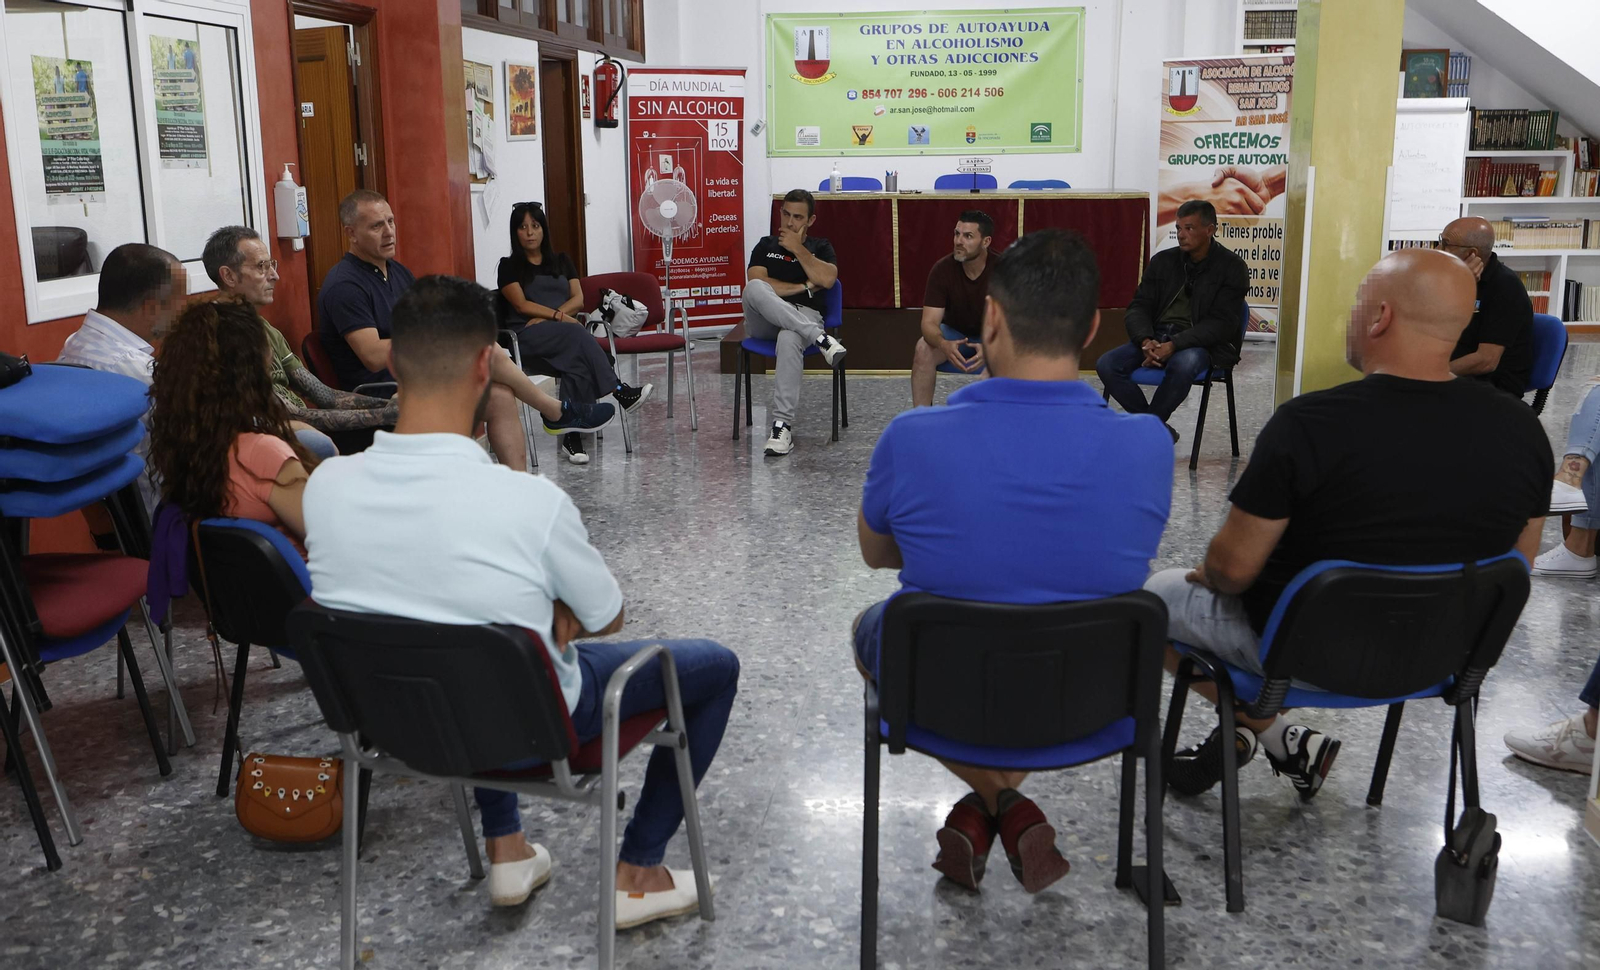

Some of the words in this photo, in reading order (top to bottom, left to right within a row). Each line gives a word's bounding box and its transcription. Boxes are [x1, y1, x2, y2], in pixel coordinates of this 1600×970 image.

[860, 24, 926, 36] GRUPOS
[928, 23, 949, 34] DE
[954, 21, 1050, 34] AUTOAYUDA
[886, 39, 907, 50] EN
[911, 37, 1024, 50] ALCOHOLISMO
[871, 54, 880, 65] Y
[886, 53, 939, 65] OTRAS
[944, 52, 1039, 64] ADICCIONES
[1202, 66, 1250, 80] ASOCIACIÓN
[1251, 67, 1262, 78] DE
[649, 78, 668, 92] DÍA
[672, 78, 725, 92] MUNDIAL
[1227, 80, 1290, 94] REHABILITADOS
[862, 89, 882, 100] 854
[884, 88, 902, 100] 707
[908, 88, 928, 99] 296
[938, 87, 958, 98] 606
[961, 87, 981, 98] 214
[984, 87, 1004, 98] 506
[638, 100, 662, 115] SIN
[667, 100, 737, 116] ALCOHOL
[1238, 98, 1254, 108] SAN
[1256, 96, 1276, 108] JOSÉ
[890, 105, 975, 115] ar.san.jose@hotmail.com
[1235, 116, 1247, 126] AR
[1248, 114, 1265, 125] SAN
[1266, 112, 1288, 124] JOSÉ
[715, 122, 728, 136] 15
[711, 137, 737, 149] nov.
[1194, 132, 1281, 150] OFRECEMOS
[1168, 154, 1216, 165] GRUPOS
[1218, 154, 1234, 164] DE
[705, 178, 714, 186] La
[715, 177, 730, 186] vida
[708, 189, 737, 197] libertad.
[709, 214, 737, 222] ¿Deseas
[1222, 223, 1250, 238] Tienes
[1252, 223, 1282, 242] proble
[1252, 245, 1259, 260] el
[1262, 245, 1280, 261] alco
[1261, 268, 1266, 280] a
